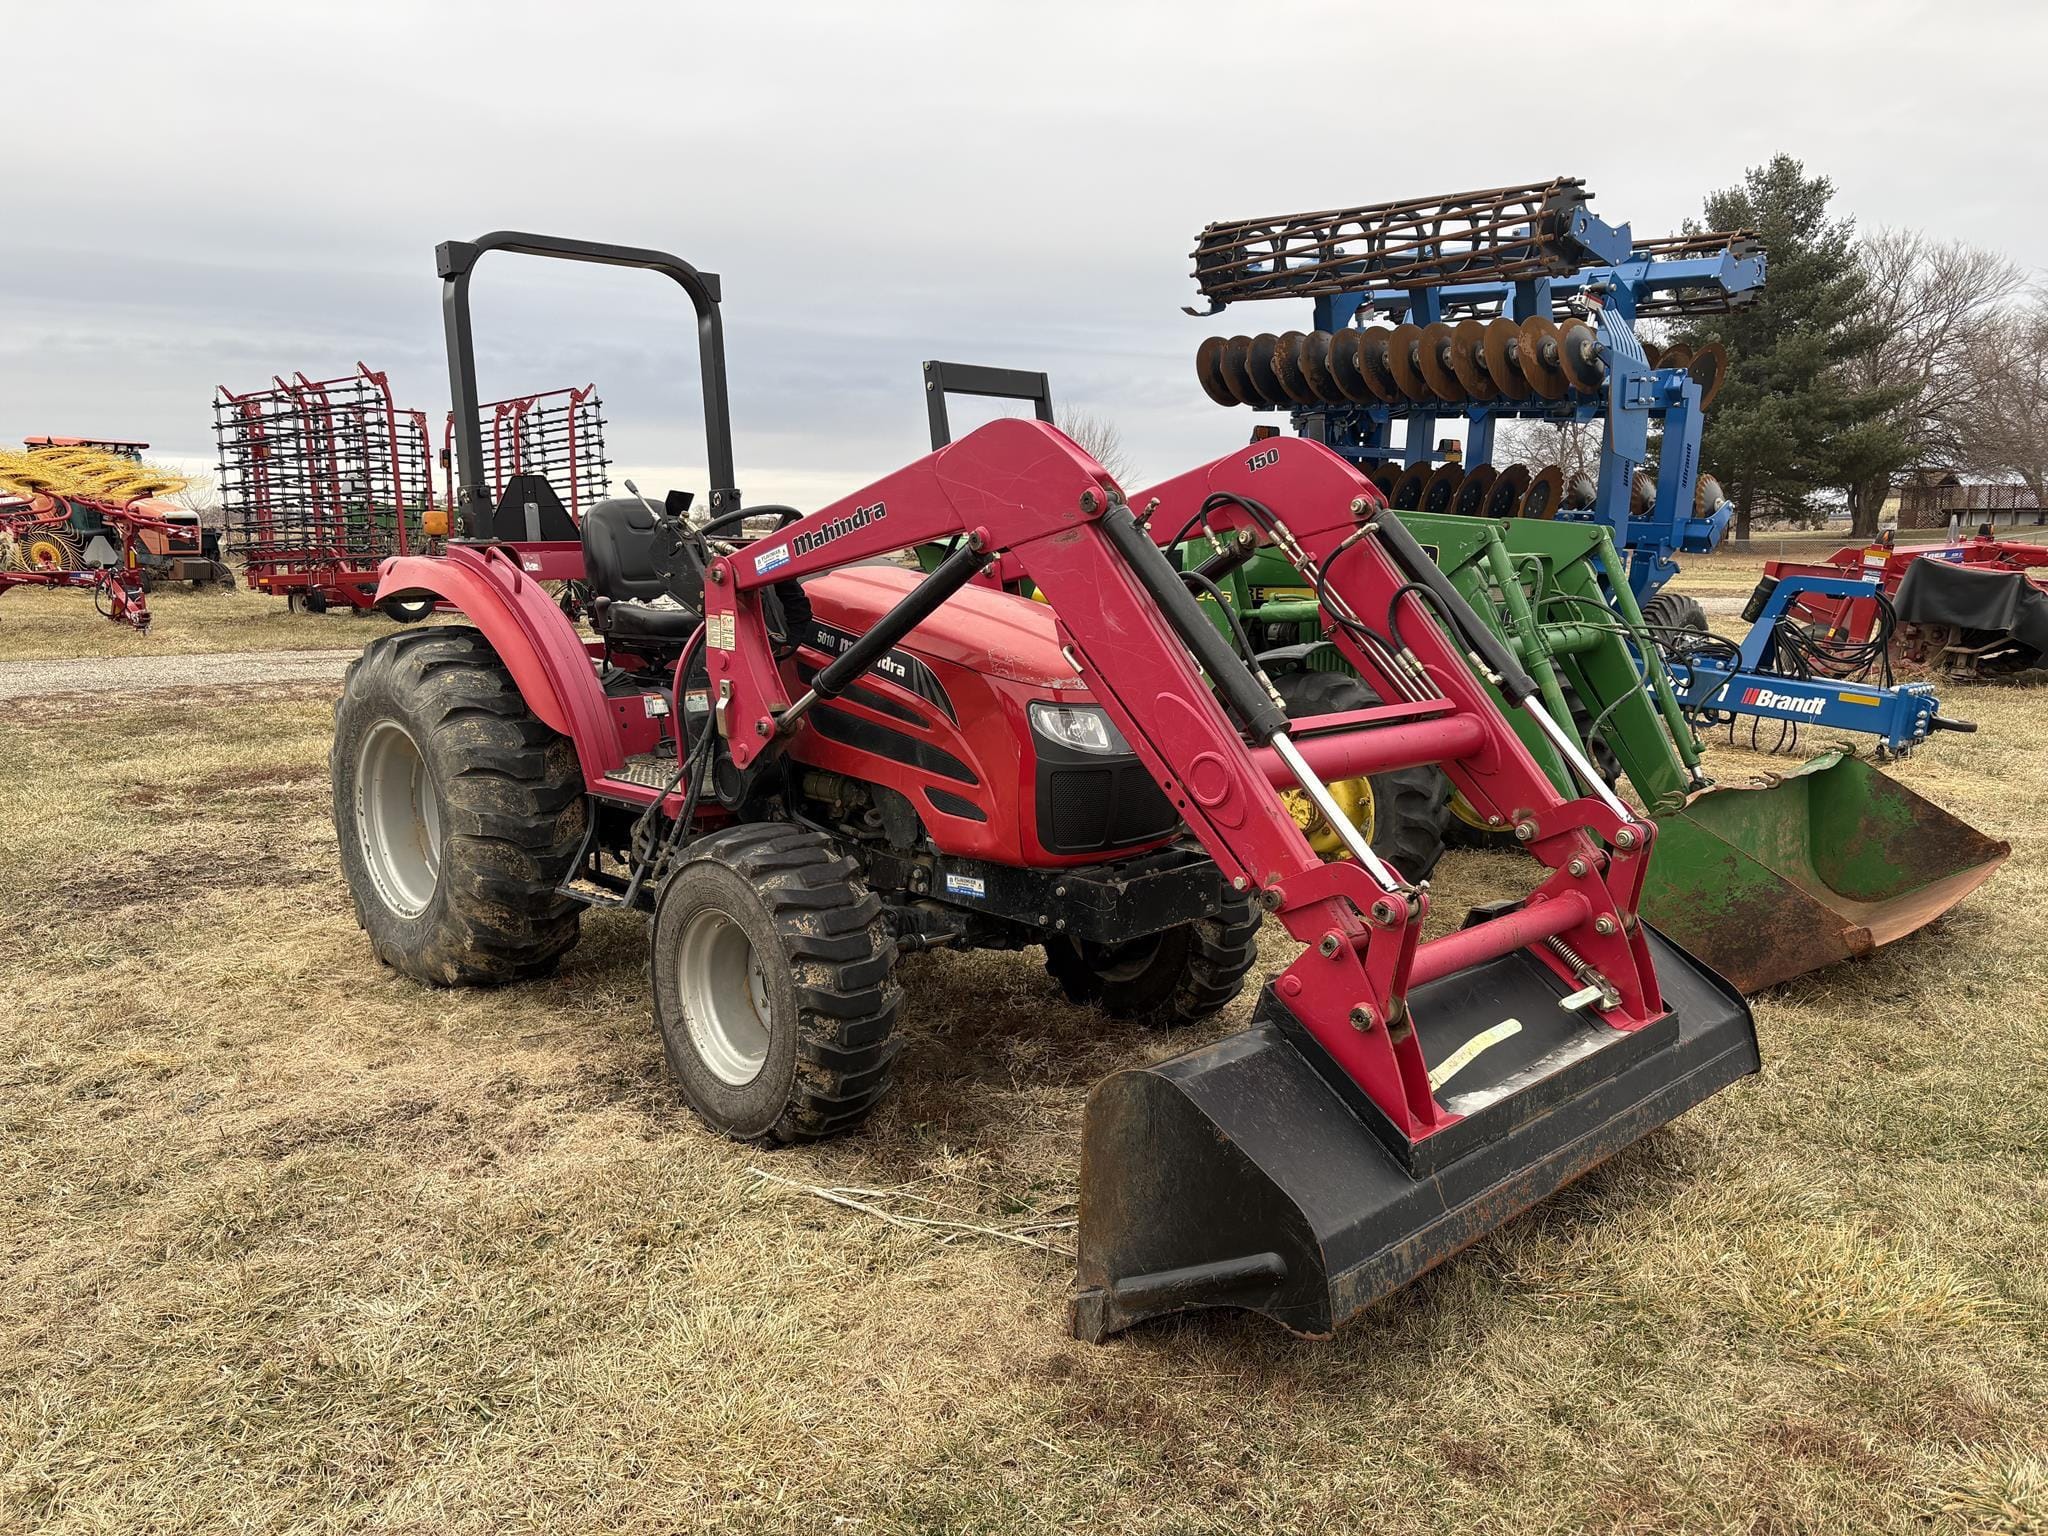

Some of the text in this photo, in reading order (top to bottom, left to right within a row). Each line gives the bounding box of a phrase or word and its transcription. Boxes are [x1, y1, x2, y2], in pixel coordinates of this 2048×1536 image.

[1245, 448, 1279, 472] 150
[793, 502, 887, 557] Mahindra
[817, 631, 835, 648] 5010
[1754, 691, 1826, 715] Brandt
